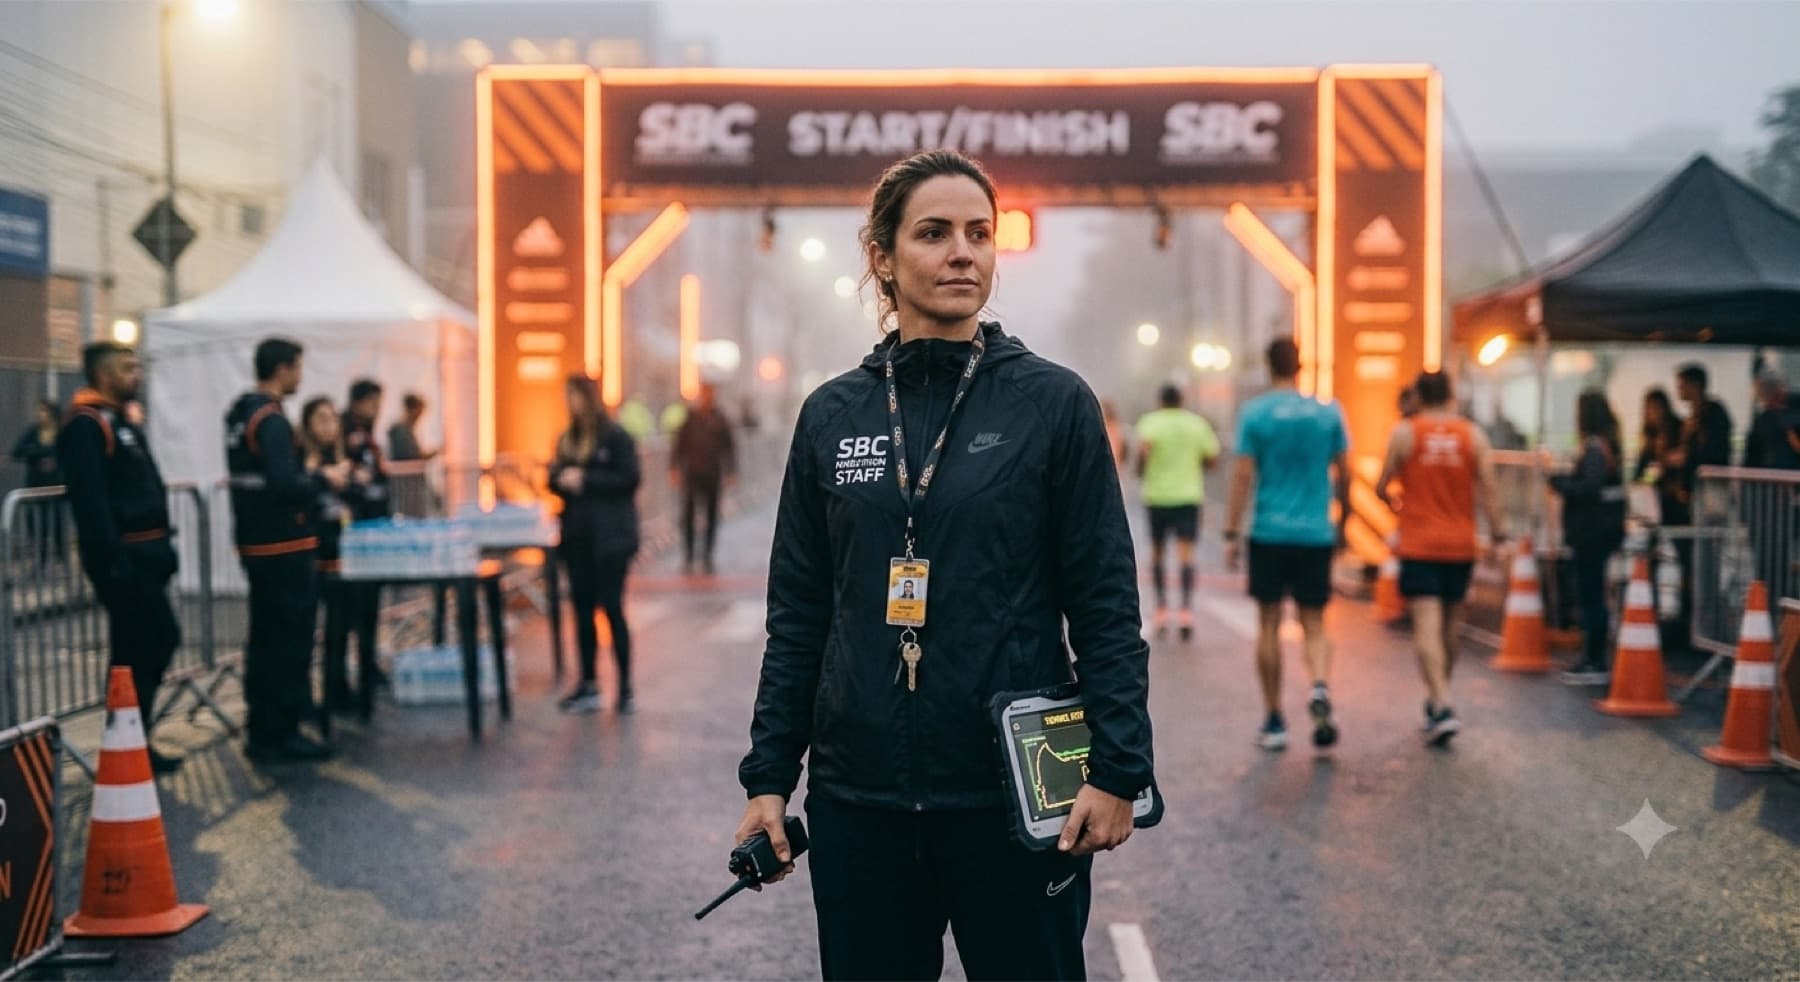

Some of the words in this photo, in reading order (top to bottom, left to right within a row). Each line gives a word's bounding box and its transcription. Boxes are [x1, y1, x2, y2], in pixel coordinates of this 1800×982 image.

[636, 103, 757, 153] SBC
[788, 107, 1130, 155] START/FINISH
[1161, 102, 1283, 154] SBC
[836, 435, 889, 458] SBC
[835, 467, 885, 485] STAFF
